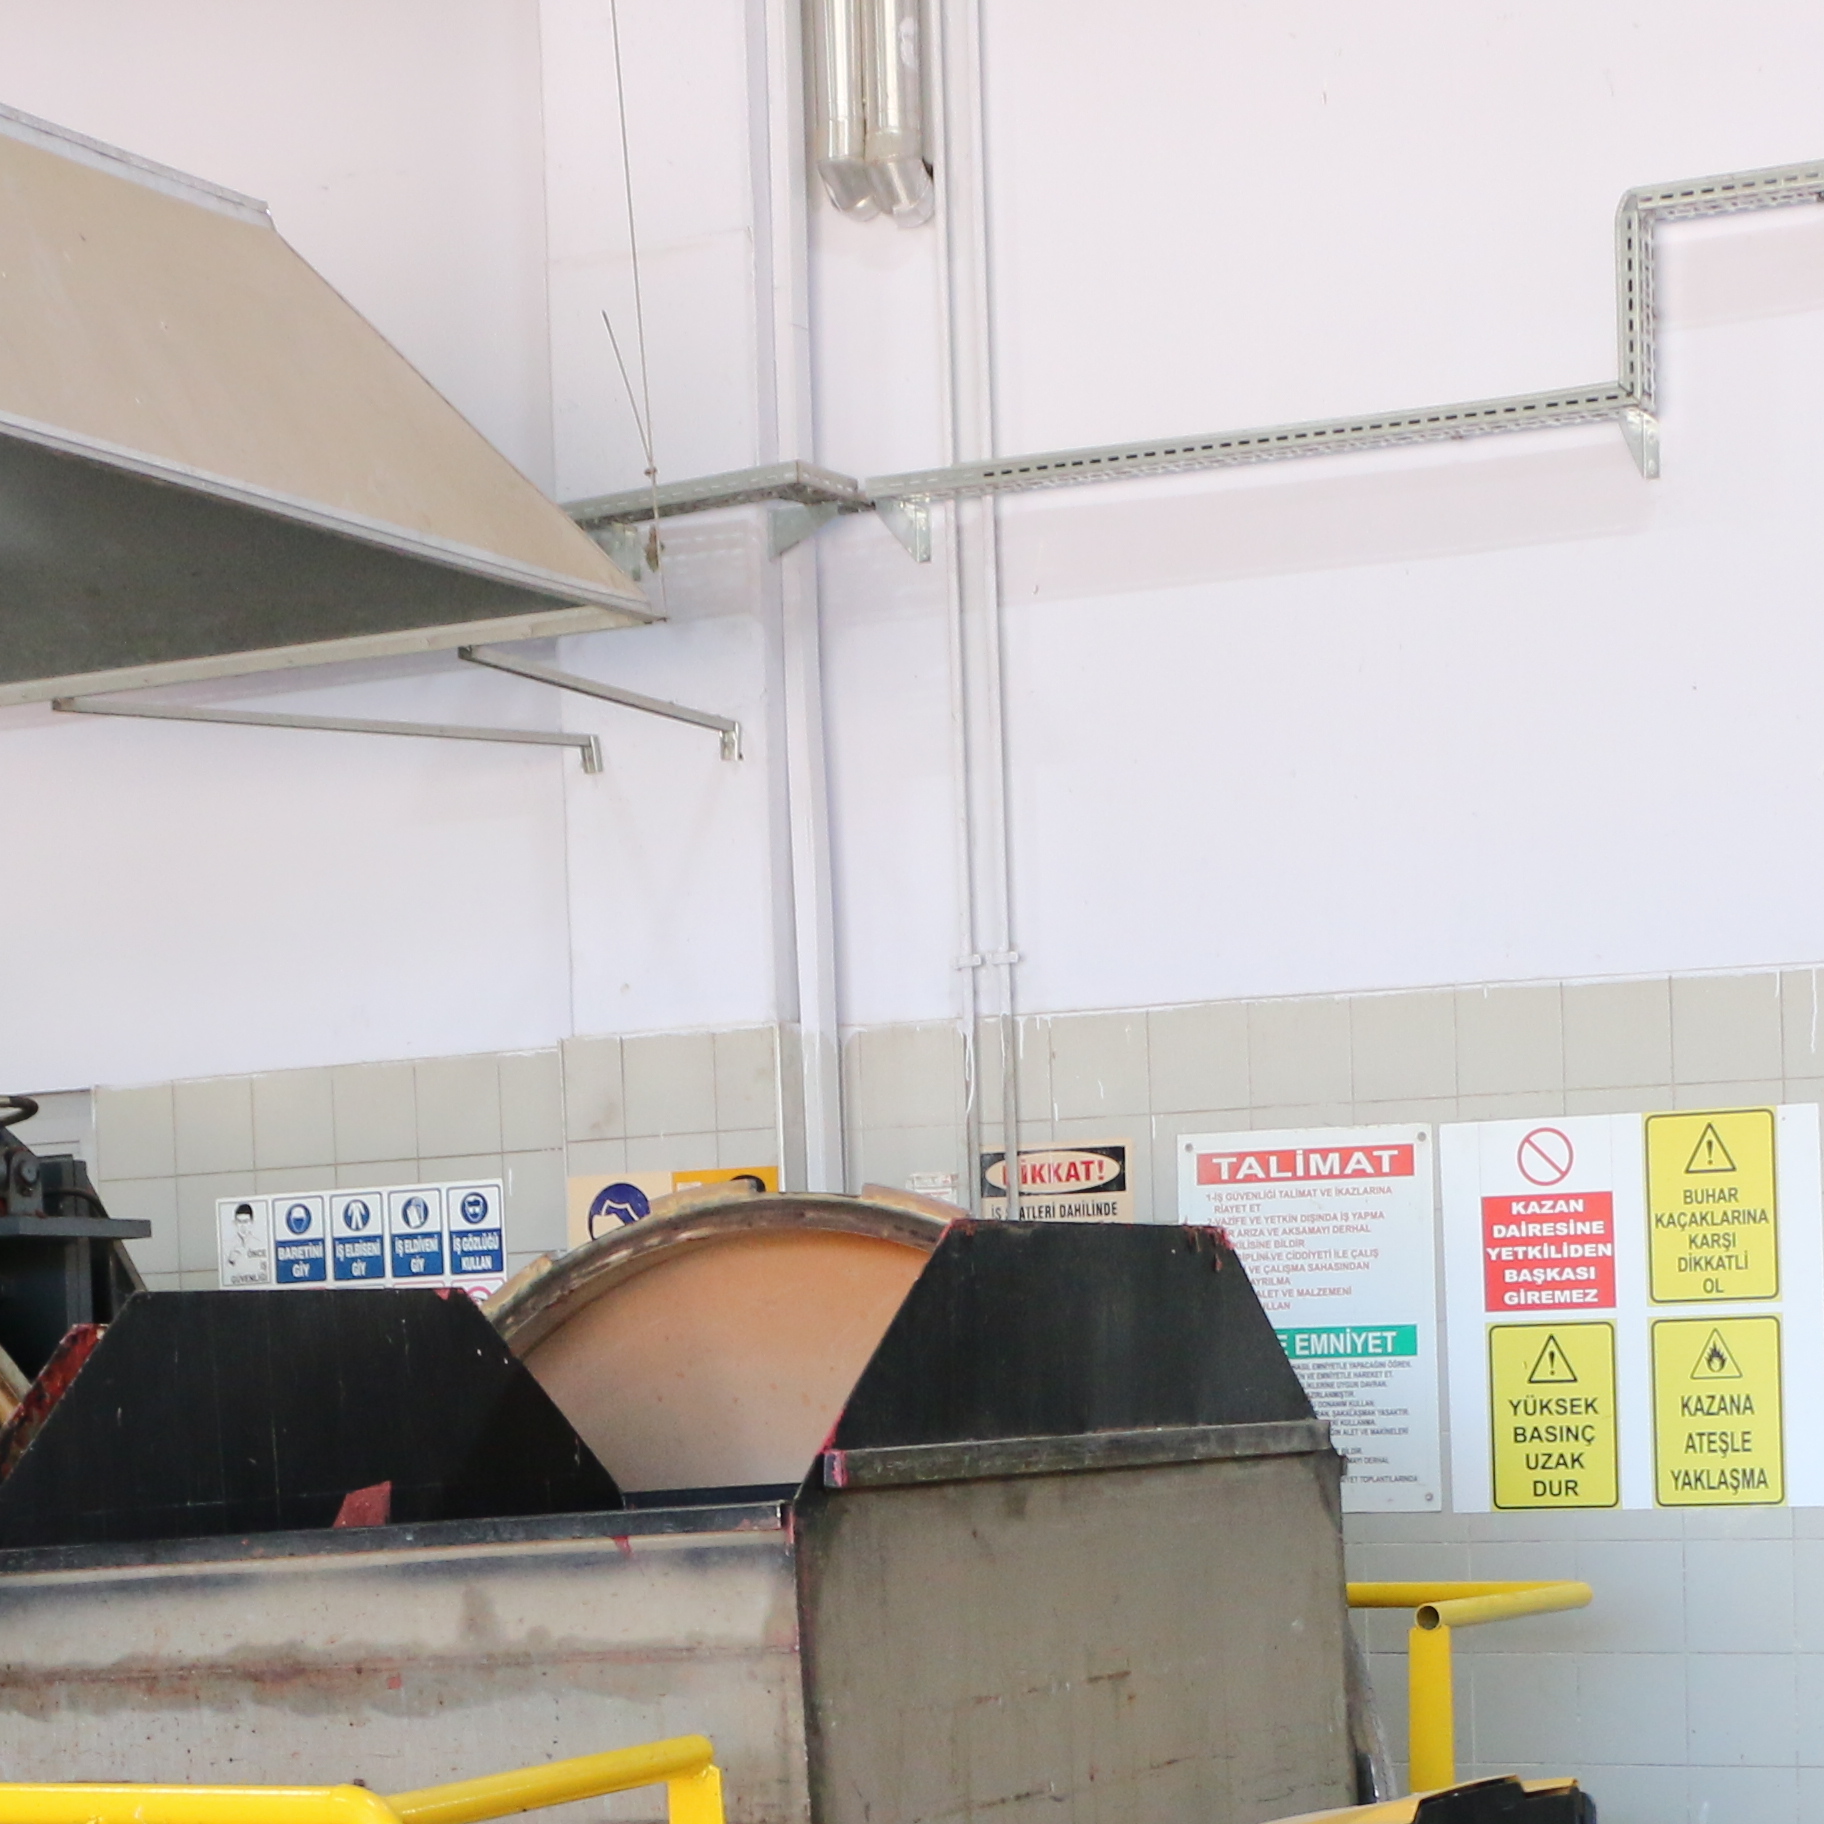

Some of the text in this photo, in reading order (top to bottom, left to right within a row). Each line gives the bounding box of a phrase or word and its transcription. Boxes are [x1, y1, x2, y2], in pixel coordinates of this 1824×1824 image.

[1212, 1149, 1399, 1180] TALİMAT
[1279, 1188, 1318, 1198] TALİMAT
[1320, 1188, 1332, 1197] VE
[1683, 1187, 1739, 1205] BUHAR
[1006, 1202, 1056, 1220] ATLERİ
[1059, 1199, 1118, 1218] DAHİLİNDE
[1249, 1203, 1261, 1212] ET
[1511, 1199, 1583, 1214] KAZAN
[1250, 1215, 1262, 1225] VE
[1352, 1211, 1385, 1220] YAPMA
[1655, 1209, 1769, 1229] KAÇAKLARINA
[1267, 1227, 1279, 1236] VE
[1332, 1224, 1371, 1234] DERHAL
[1493, 1219, 1605, 1238] DAİRESİNE
[277, 1241, 323, 1260] BARETİNİ
[1688, 1232, 1736, 1251] KARŞI
[1486, 1242, 1612, 1261] YETKİLİDEN
[292, 1261, 311, 1277] GİY
[351, 1258, 367, 1276] GİY
[410, 1254, 425, 1273] GİY
[461, 1255, 492, 1271] KULLAN
[1249, 1265, 1261, 1274] VE
[1307, 1261, 1370, 1272] SAHASINDAN
[1678, 1251, 1748, 1273] DİKKATLİ
[1504, 1267, 1596, 1285] BAŞKASI
[1703, 1277, 1724, 1294] OL
[1281, 1288, 1295, 1297] VE
[1503, 1287, 1598, 1306] GİREMEZ
[1295, 1328, 1397, 1355] EMNİYET
[1508, 1394, 1599, 1416] YÜKSEK
[1680, 1393, 1754, 1417] KAZANA
[1513, 1424, 1596, 1447] BASINÇ
[1684, 1431, 1752, 1457] ATEŞLE
[1526, 1452, 1584, 1470] UZAK
[1533, 1479, 1579, 1497] DUR
[1670, 1467, 1769, 1495] YAKLAŞMA
